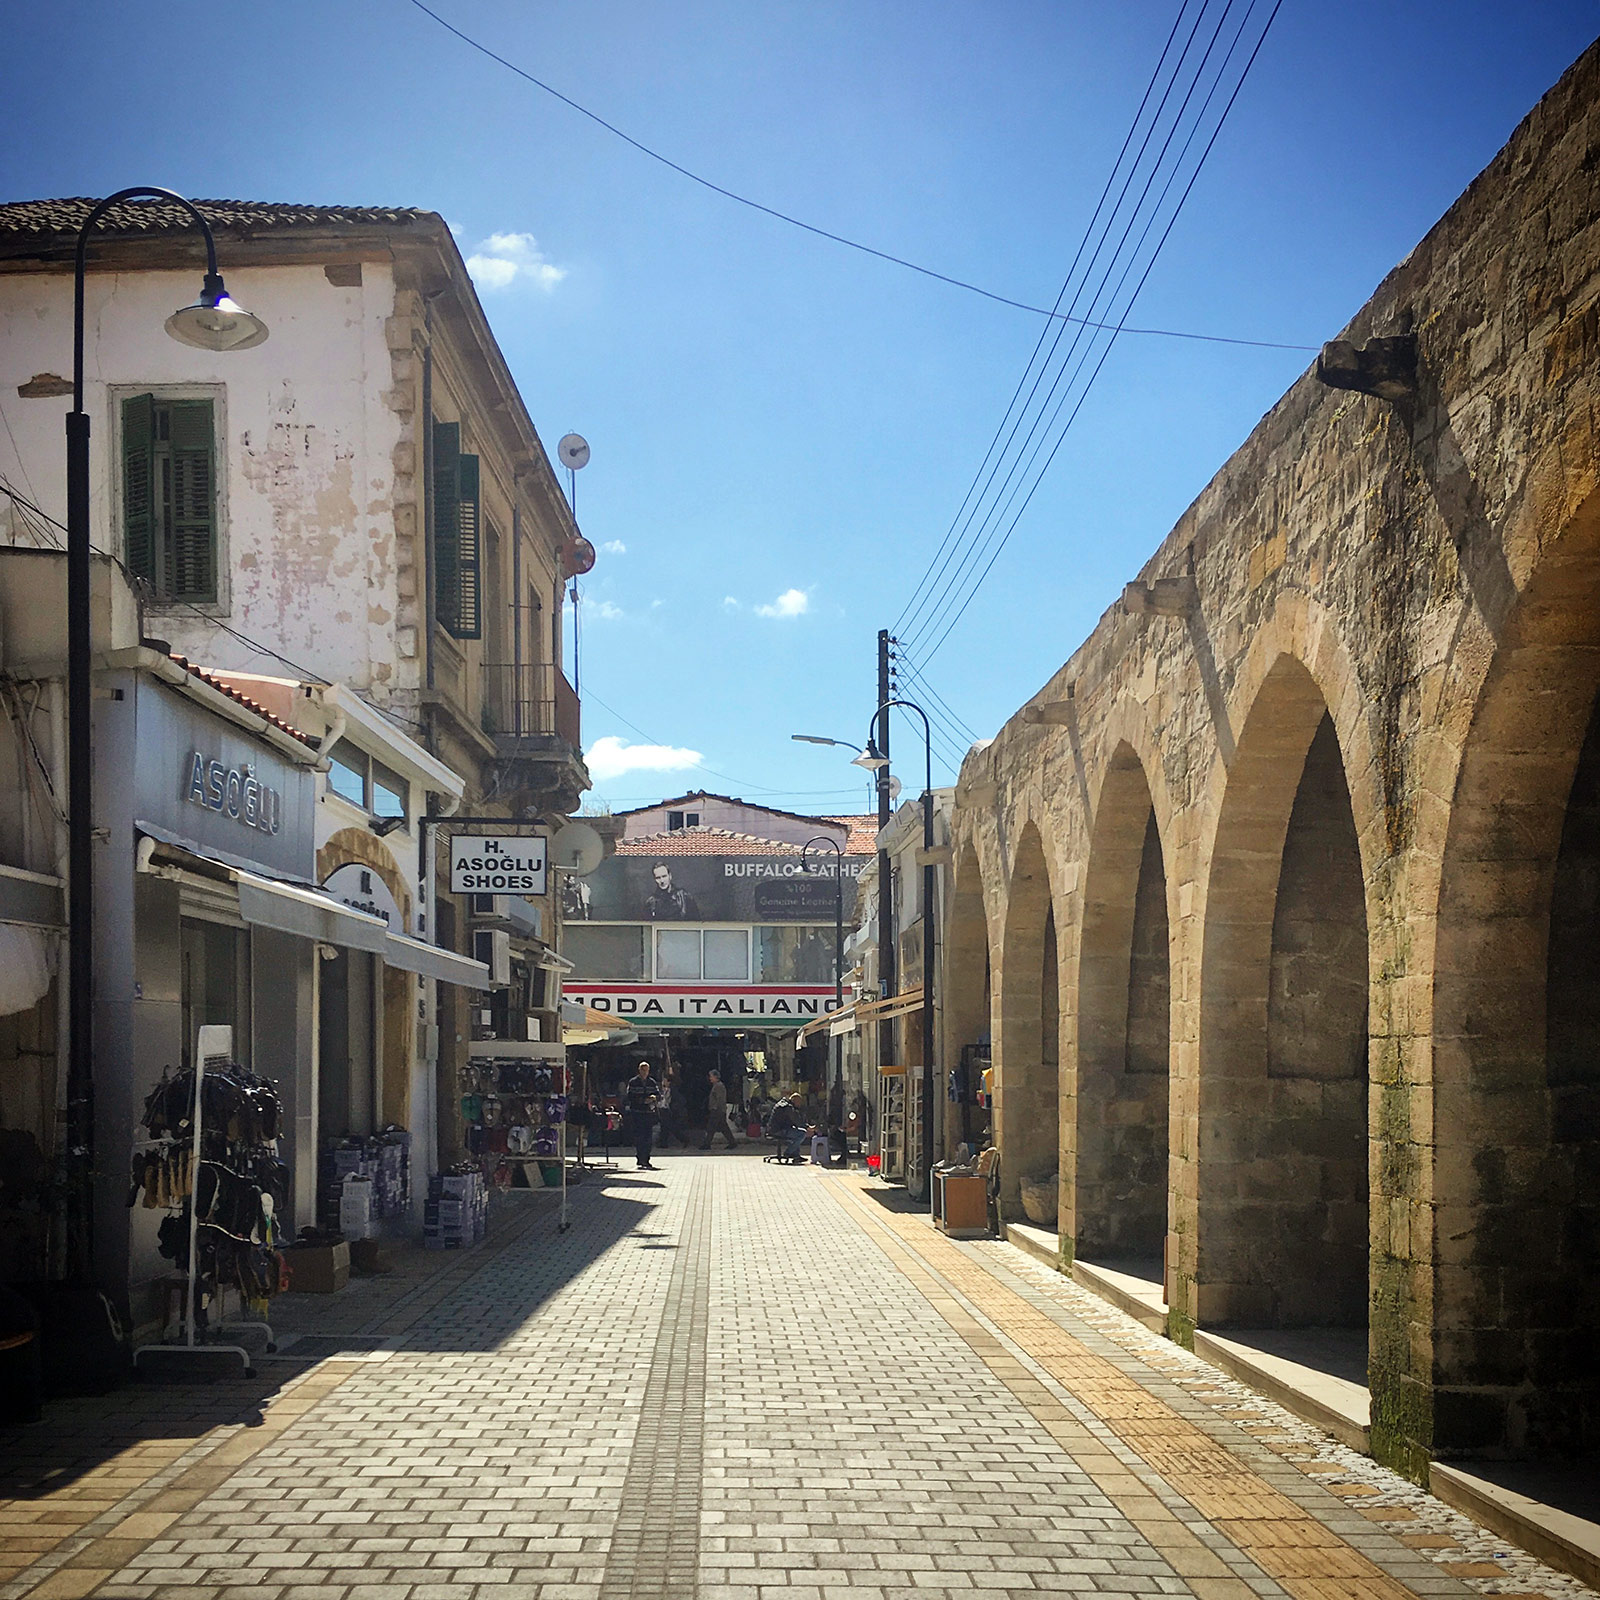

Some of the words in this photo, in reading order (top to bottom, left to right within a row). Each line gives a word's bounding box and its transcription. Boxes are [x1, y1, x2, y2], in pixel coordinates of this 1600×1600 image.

[188, 751, 281, 836] ASOĞLU
[484, 840, 505, 854] H.
[455, 855, 542, 871] ASOĞLU
[724, 863, 795, 877] BUFFALO
[808, 863, 866, 877] EATHE
[462, 874, 534, 889] SHOES
[679, 998, 844, 1014] ITALIANO
